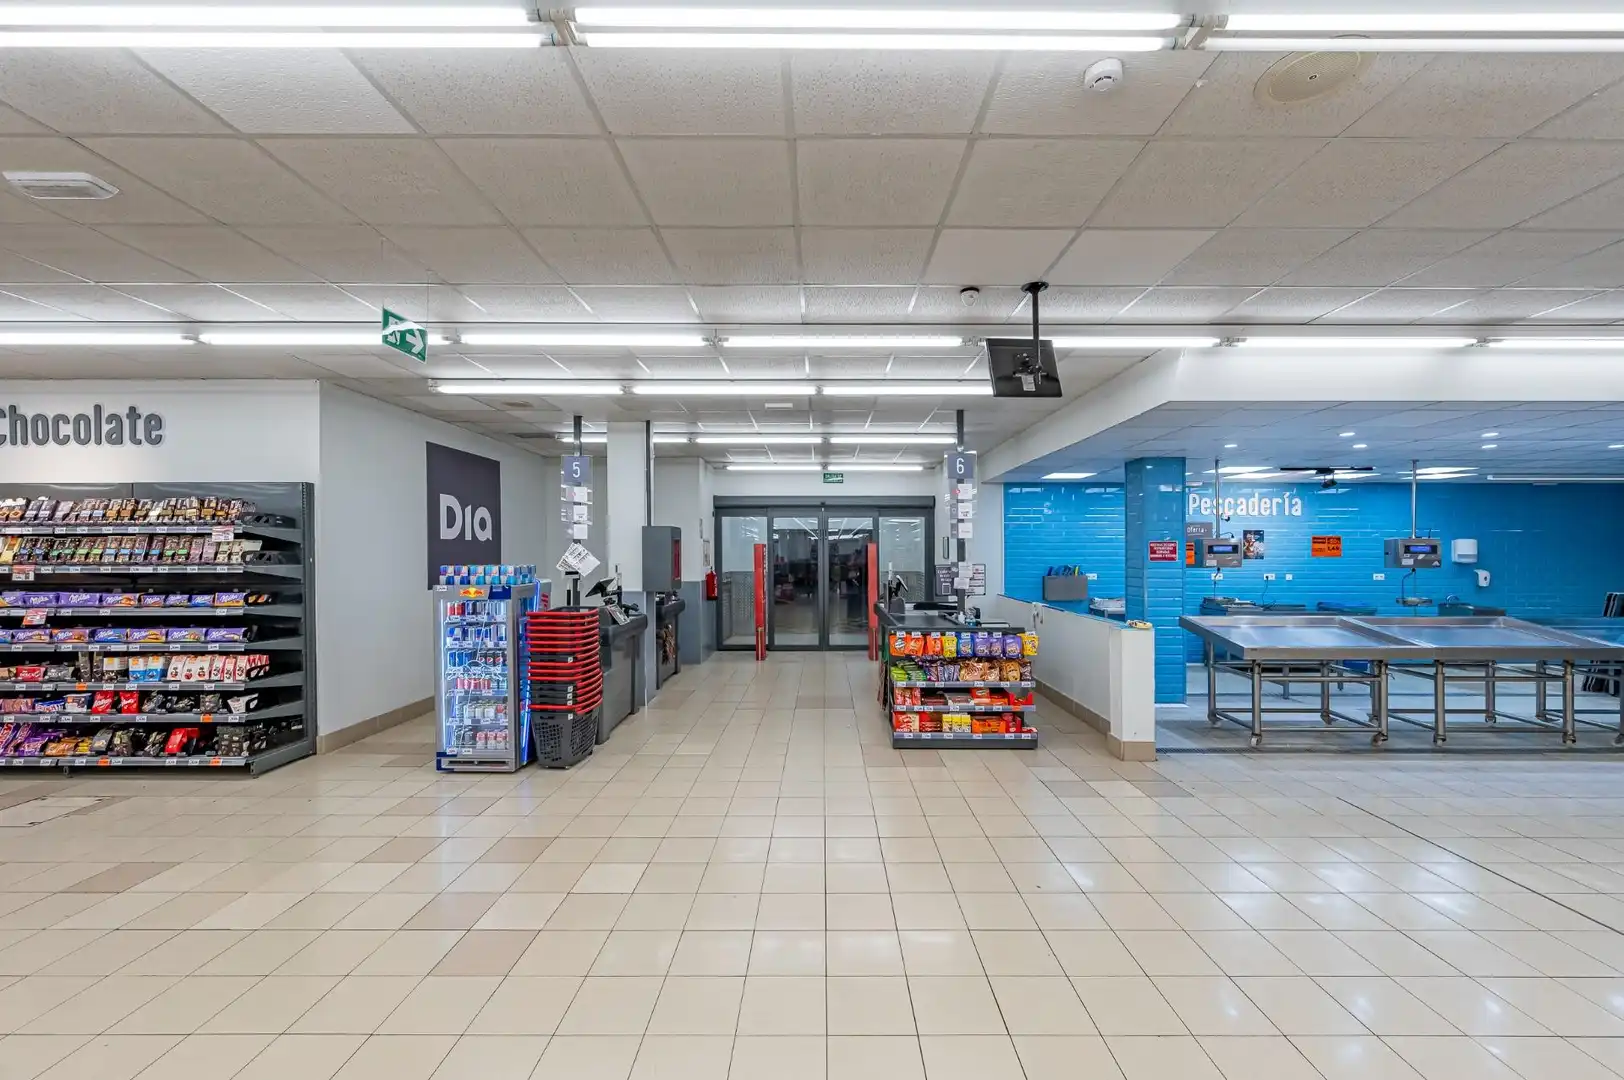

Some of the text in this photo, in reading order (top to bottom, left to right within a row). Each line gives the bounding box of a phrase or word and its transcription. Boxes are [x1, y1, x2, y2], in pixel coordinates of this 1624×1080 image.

[573, 462, 580, 478] 5
[956, 457, 965, 474] 6
[1188, 493, 1302, 516] Pescadería
[440, 493, 493, 542] Dia
